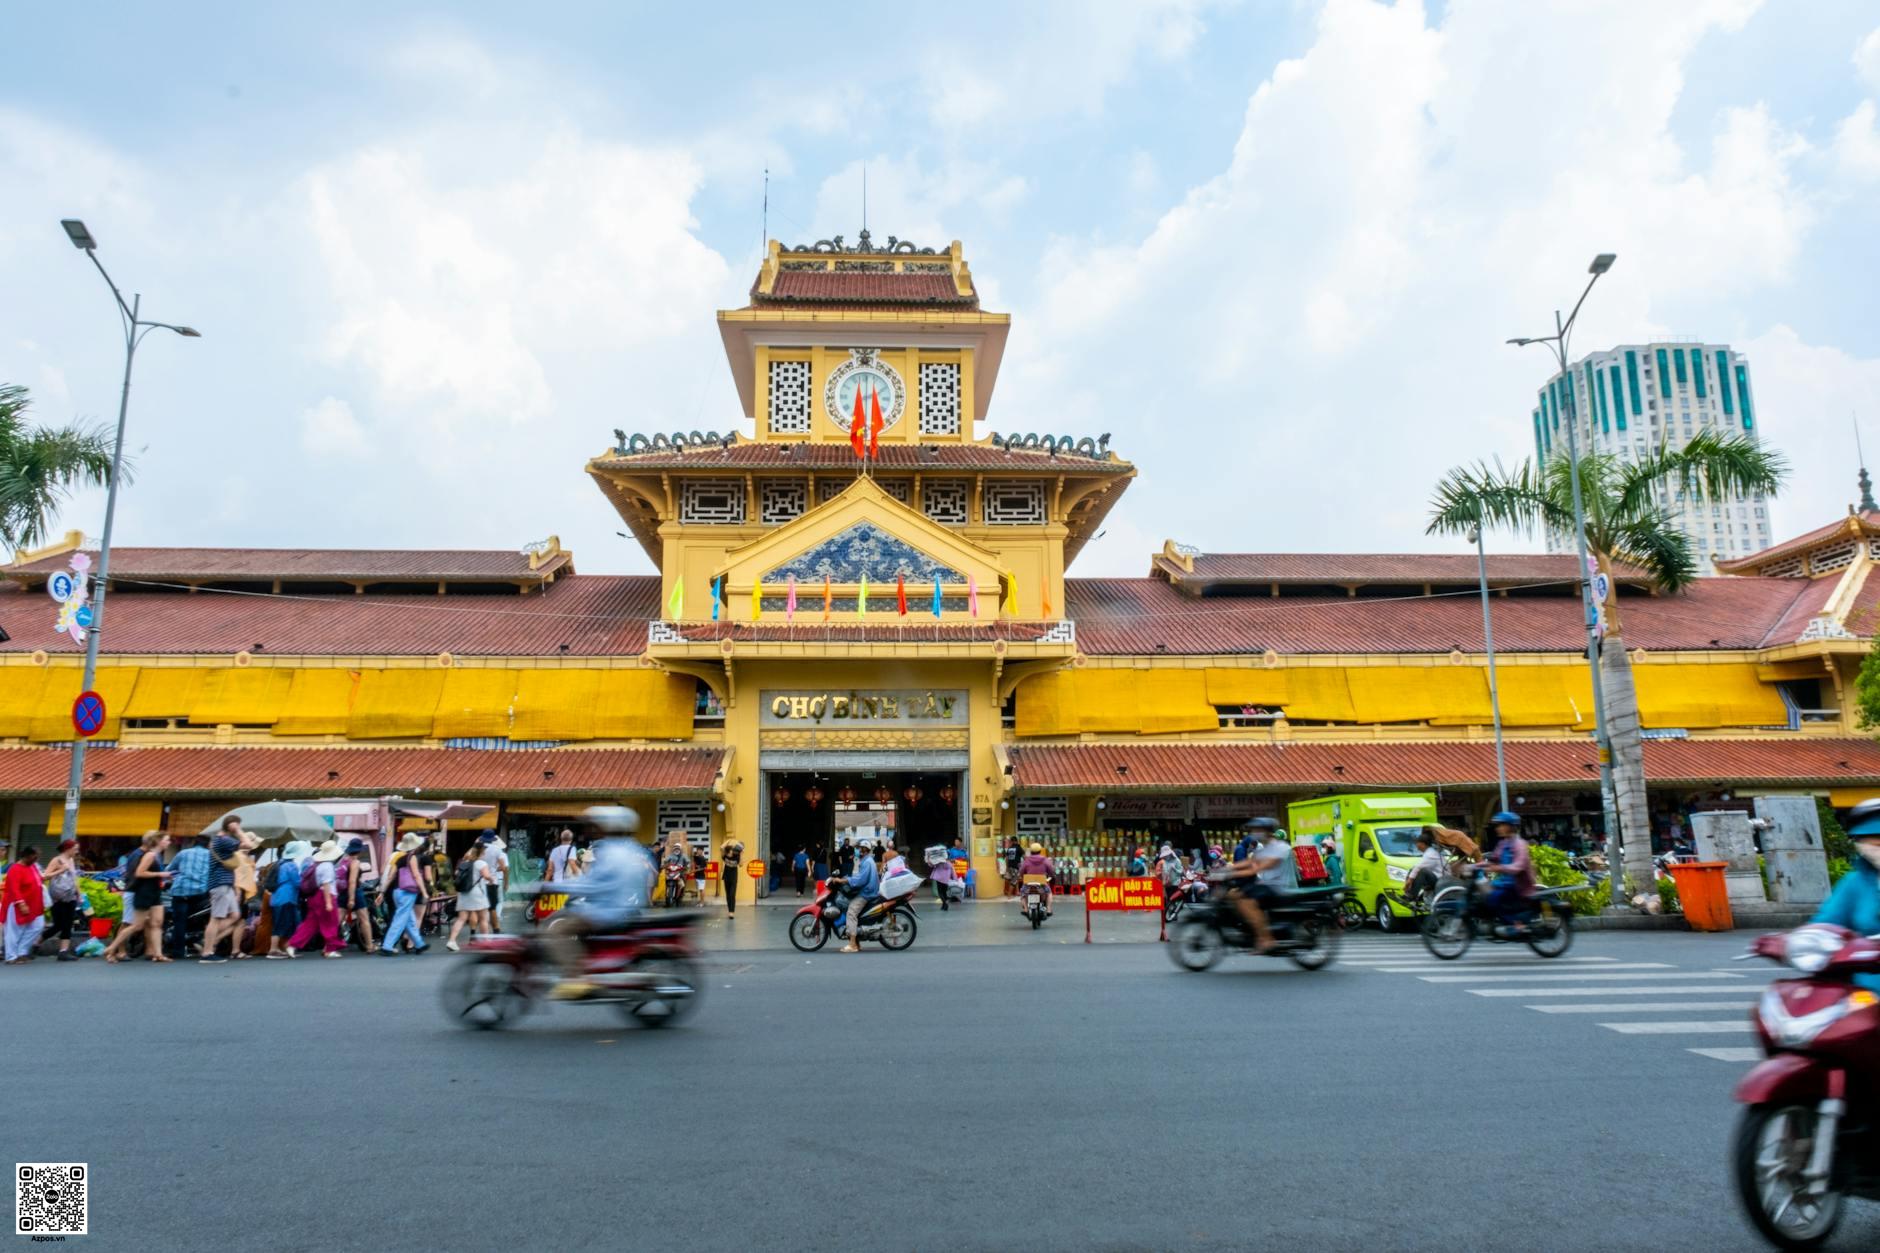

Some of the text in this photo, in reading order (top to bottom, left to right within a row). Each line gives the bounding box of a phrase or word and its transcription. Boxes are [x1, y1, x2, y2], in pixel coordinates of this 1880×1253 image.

[772, 691, 956, 724] CHỢ BÌNH TÂY
[1089, 881, 1118, 904] CẤM
[1142, 881, 1153, 891] XE
[1125, 895, 1161, 906] MUA BÁN
